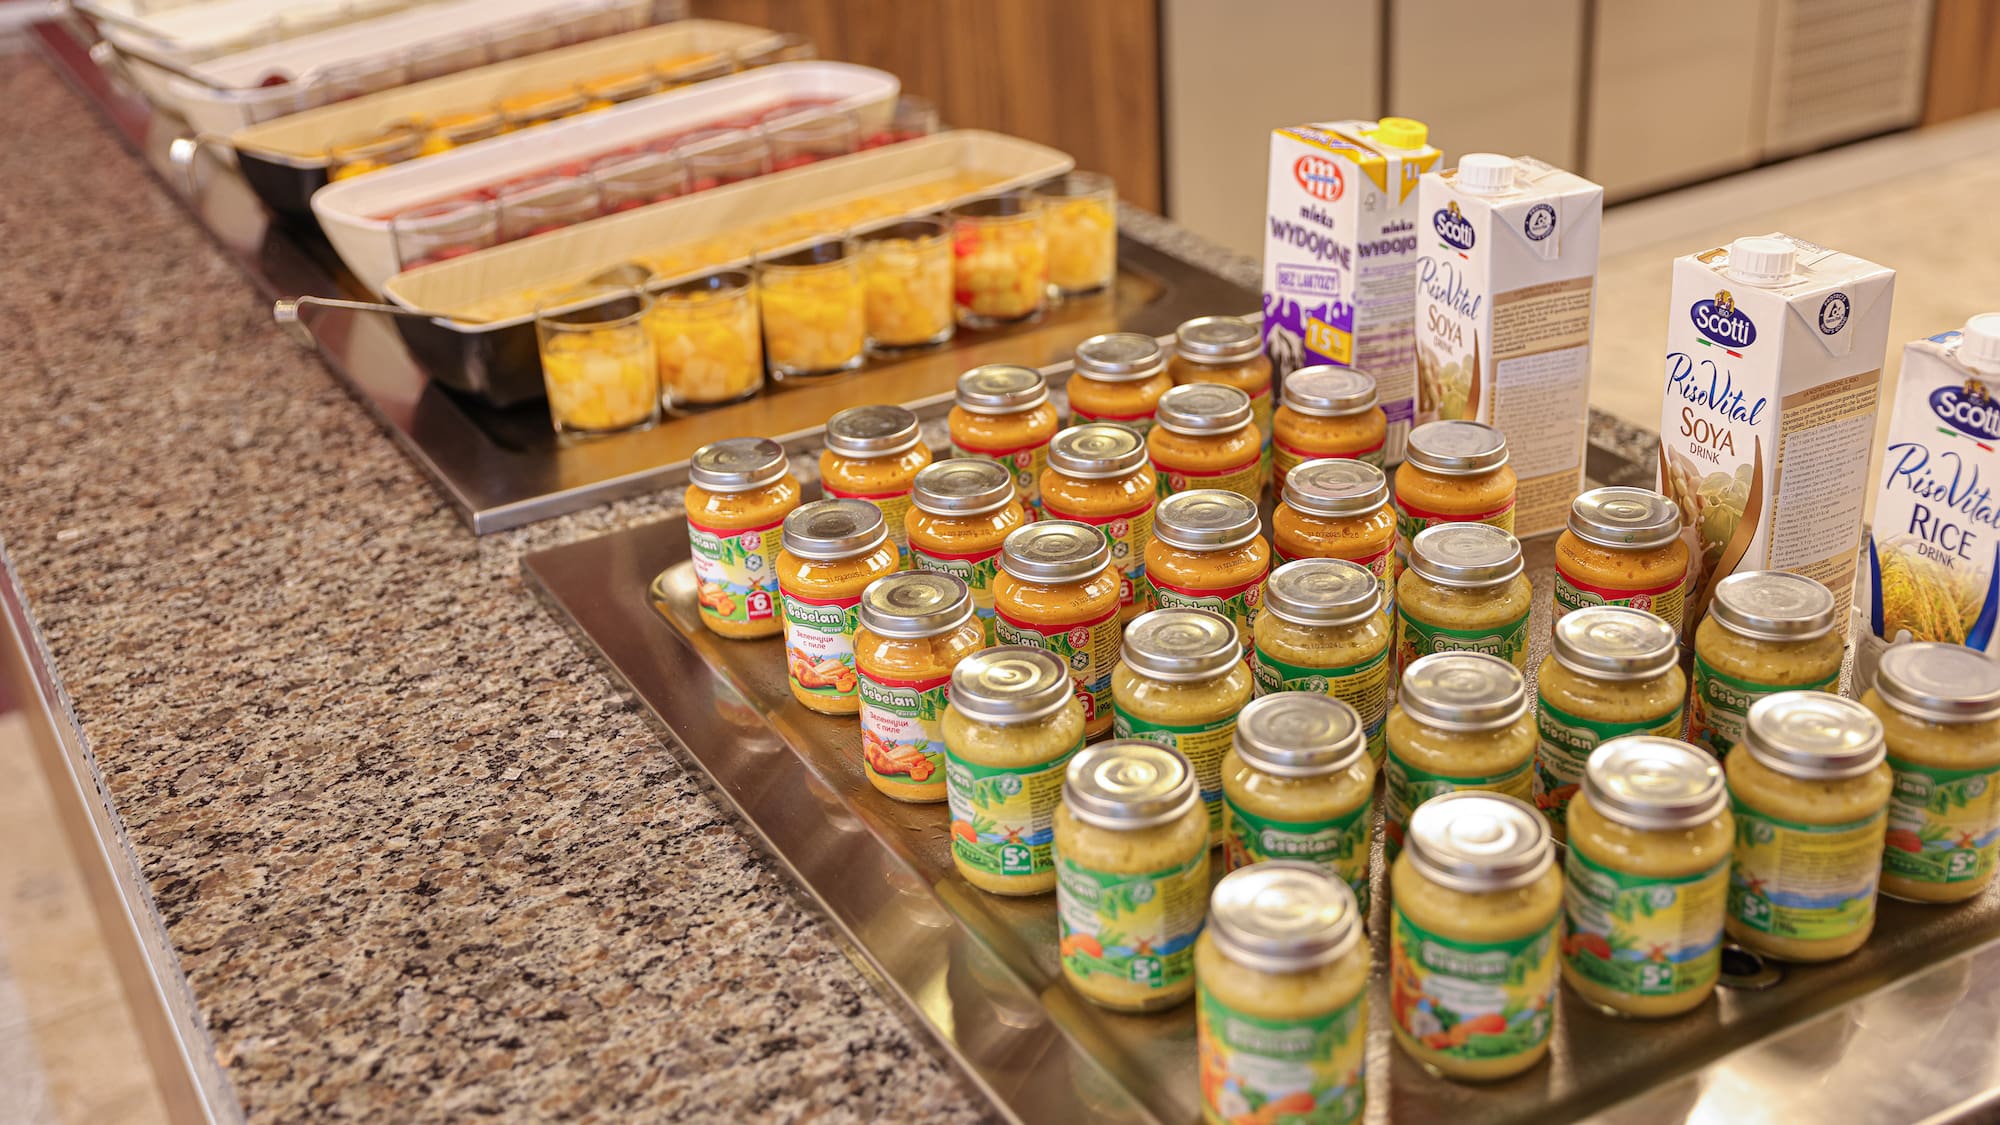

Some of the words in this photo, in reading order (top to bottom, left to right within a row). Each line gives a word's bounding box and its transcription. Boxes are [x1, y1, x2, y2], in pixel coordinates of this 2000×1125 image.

[1270, 215, 1352, 272] WYDOJONE
[1357, 234, 1417, 259] WYDOJO
[1436, 213, 1473, 249] Scotti
[1427, 303, 1464, 348] SOYA
[1695, 304, 1751, 346] Scotti
[1666, 352, 1767, 426] RisoVital
[1679, 406, 1736, 457] SOYA
[1937, 391, 2000, 438] Scott
[1689, 442, 1721, 465] DRINK
[1908, 502, 1977, 561] RICE
[1917, 541, 1956, 570] DRINK
[753, 593, 768, 611] 6
[807, 641, 826, 650] пиле
[1003, 847, 1029, 866] 5+
